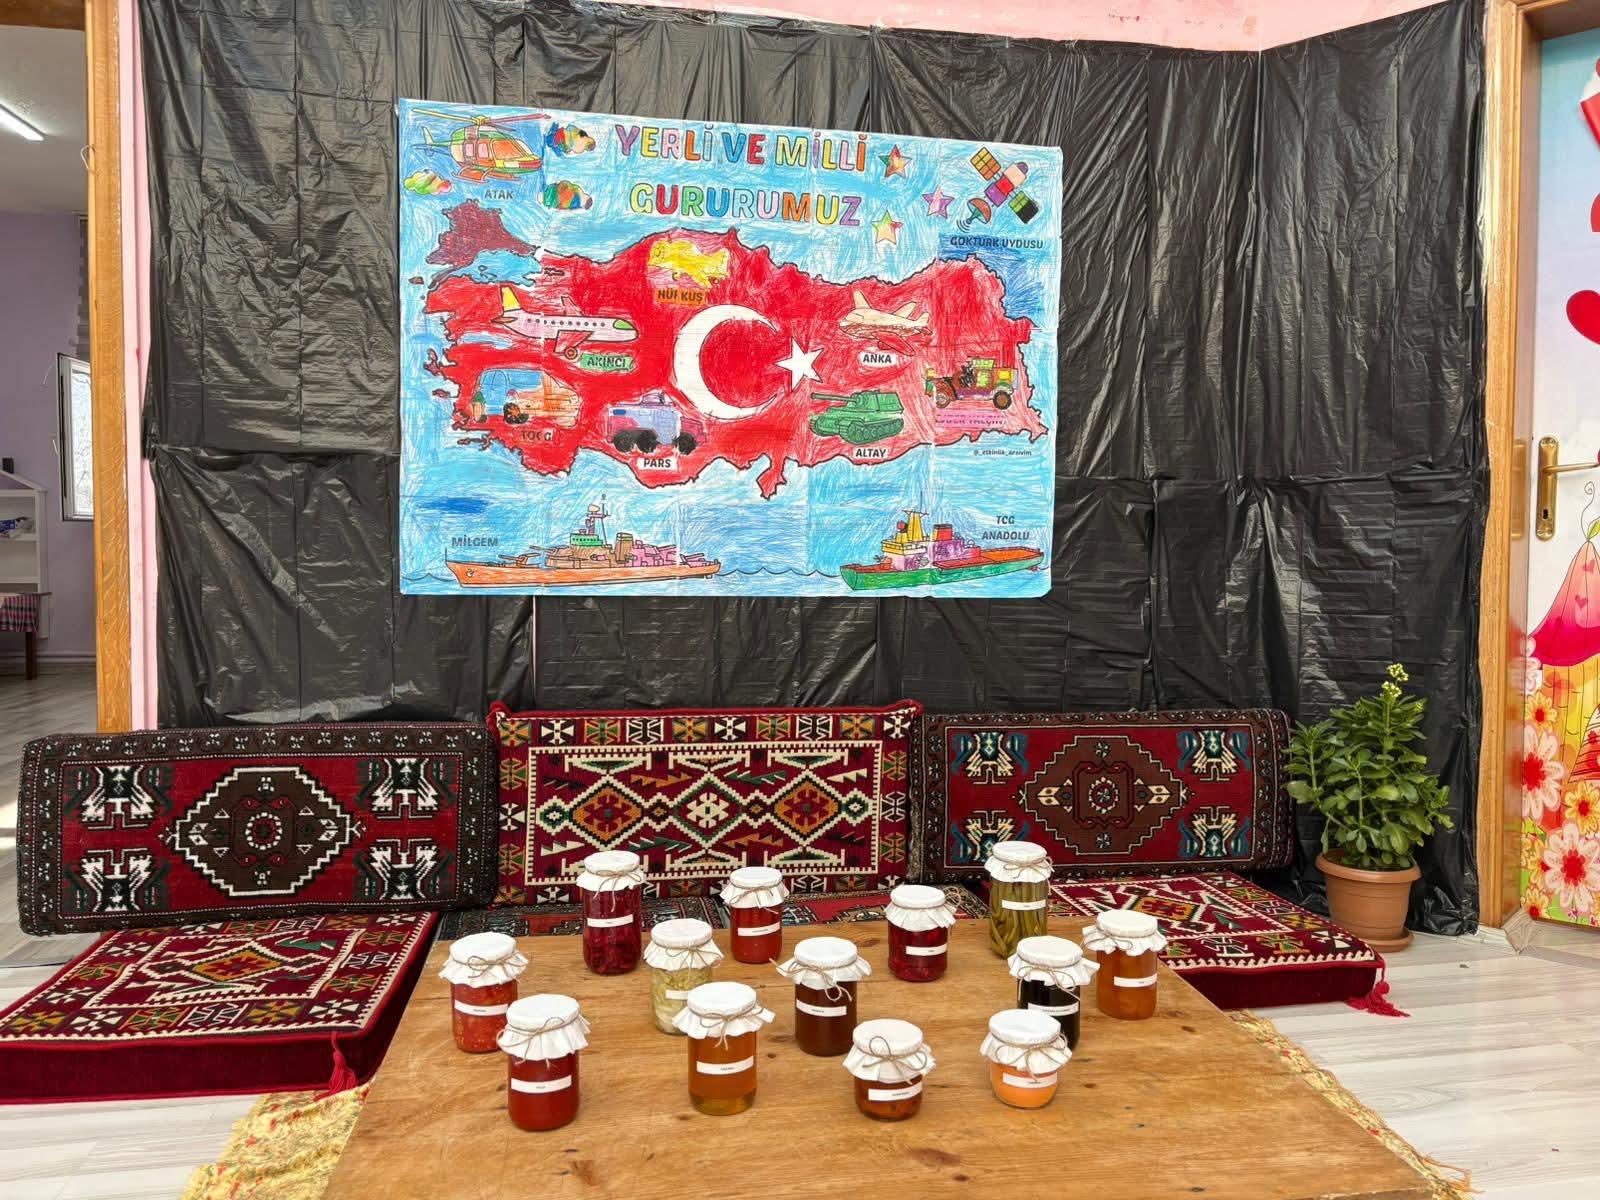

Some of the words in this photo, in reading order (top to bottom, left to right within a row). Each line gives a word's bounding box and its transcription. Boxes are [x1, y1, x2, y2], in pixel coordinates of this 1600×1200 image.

[615, 123, 714, 162] YERLİ
[721, 131, 767, 165] VE
[775, 130, 868, 172] MİLLİ
[484, 189, 514, 200] ATAK
[630, 182, 863, 227] GURURUMUZ
[1002, 236, 1044, 249] UYDUSU
[862, 353, 892, 364] ANKA
[855, 448, 887, 458] ALTAY
[643, 457, 672, 468] PARS
[995, 515, 1015, 525] TCG
[451, 534, 499, 547] MİLGEM
[981, 530, 1030, 541] ANADOLU
